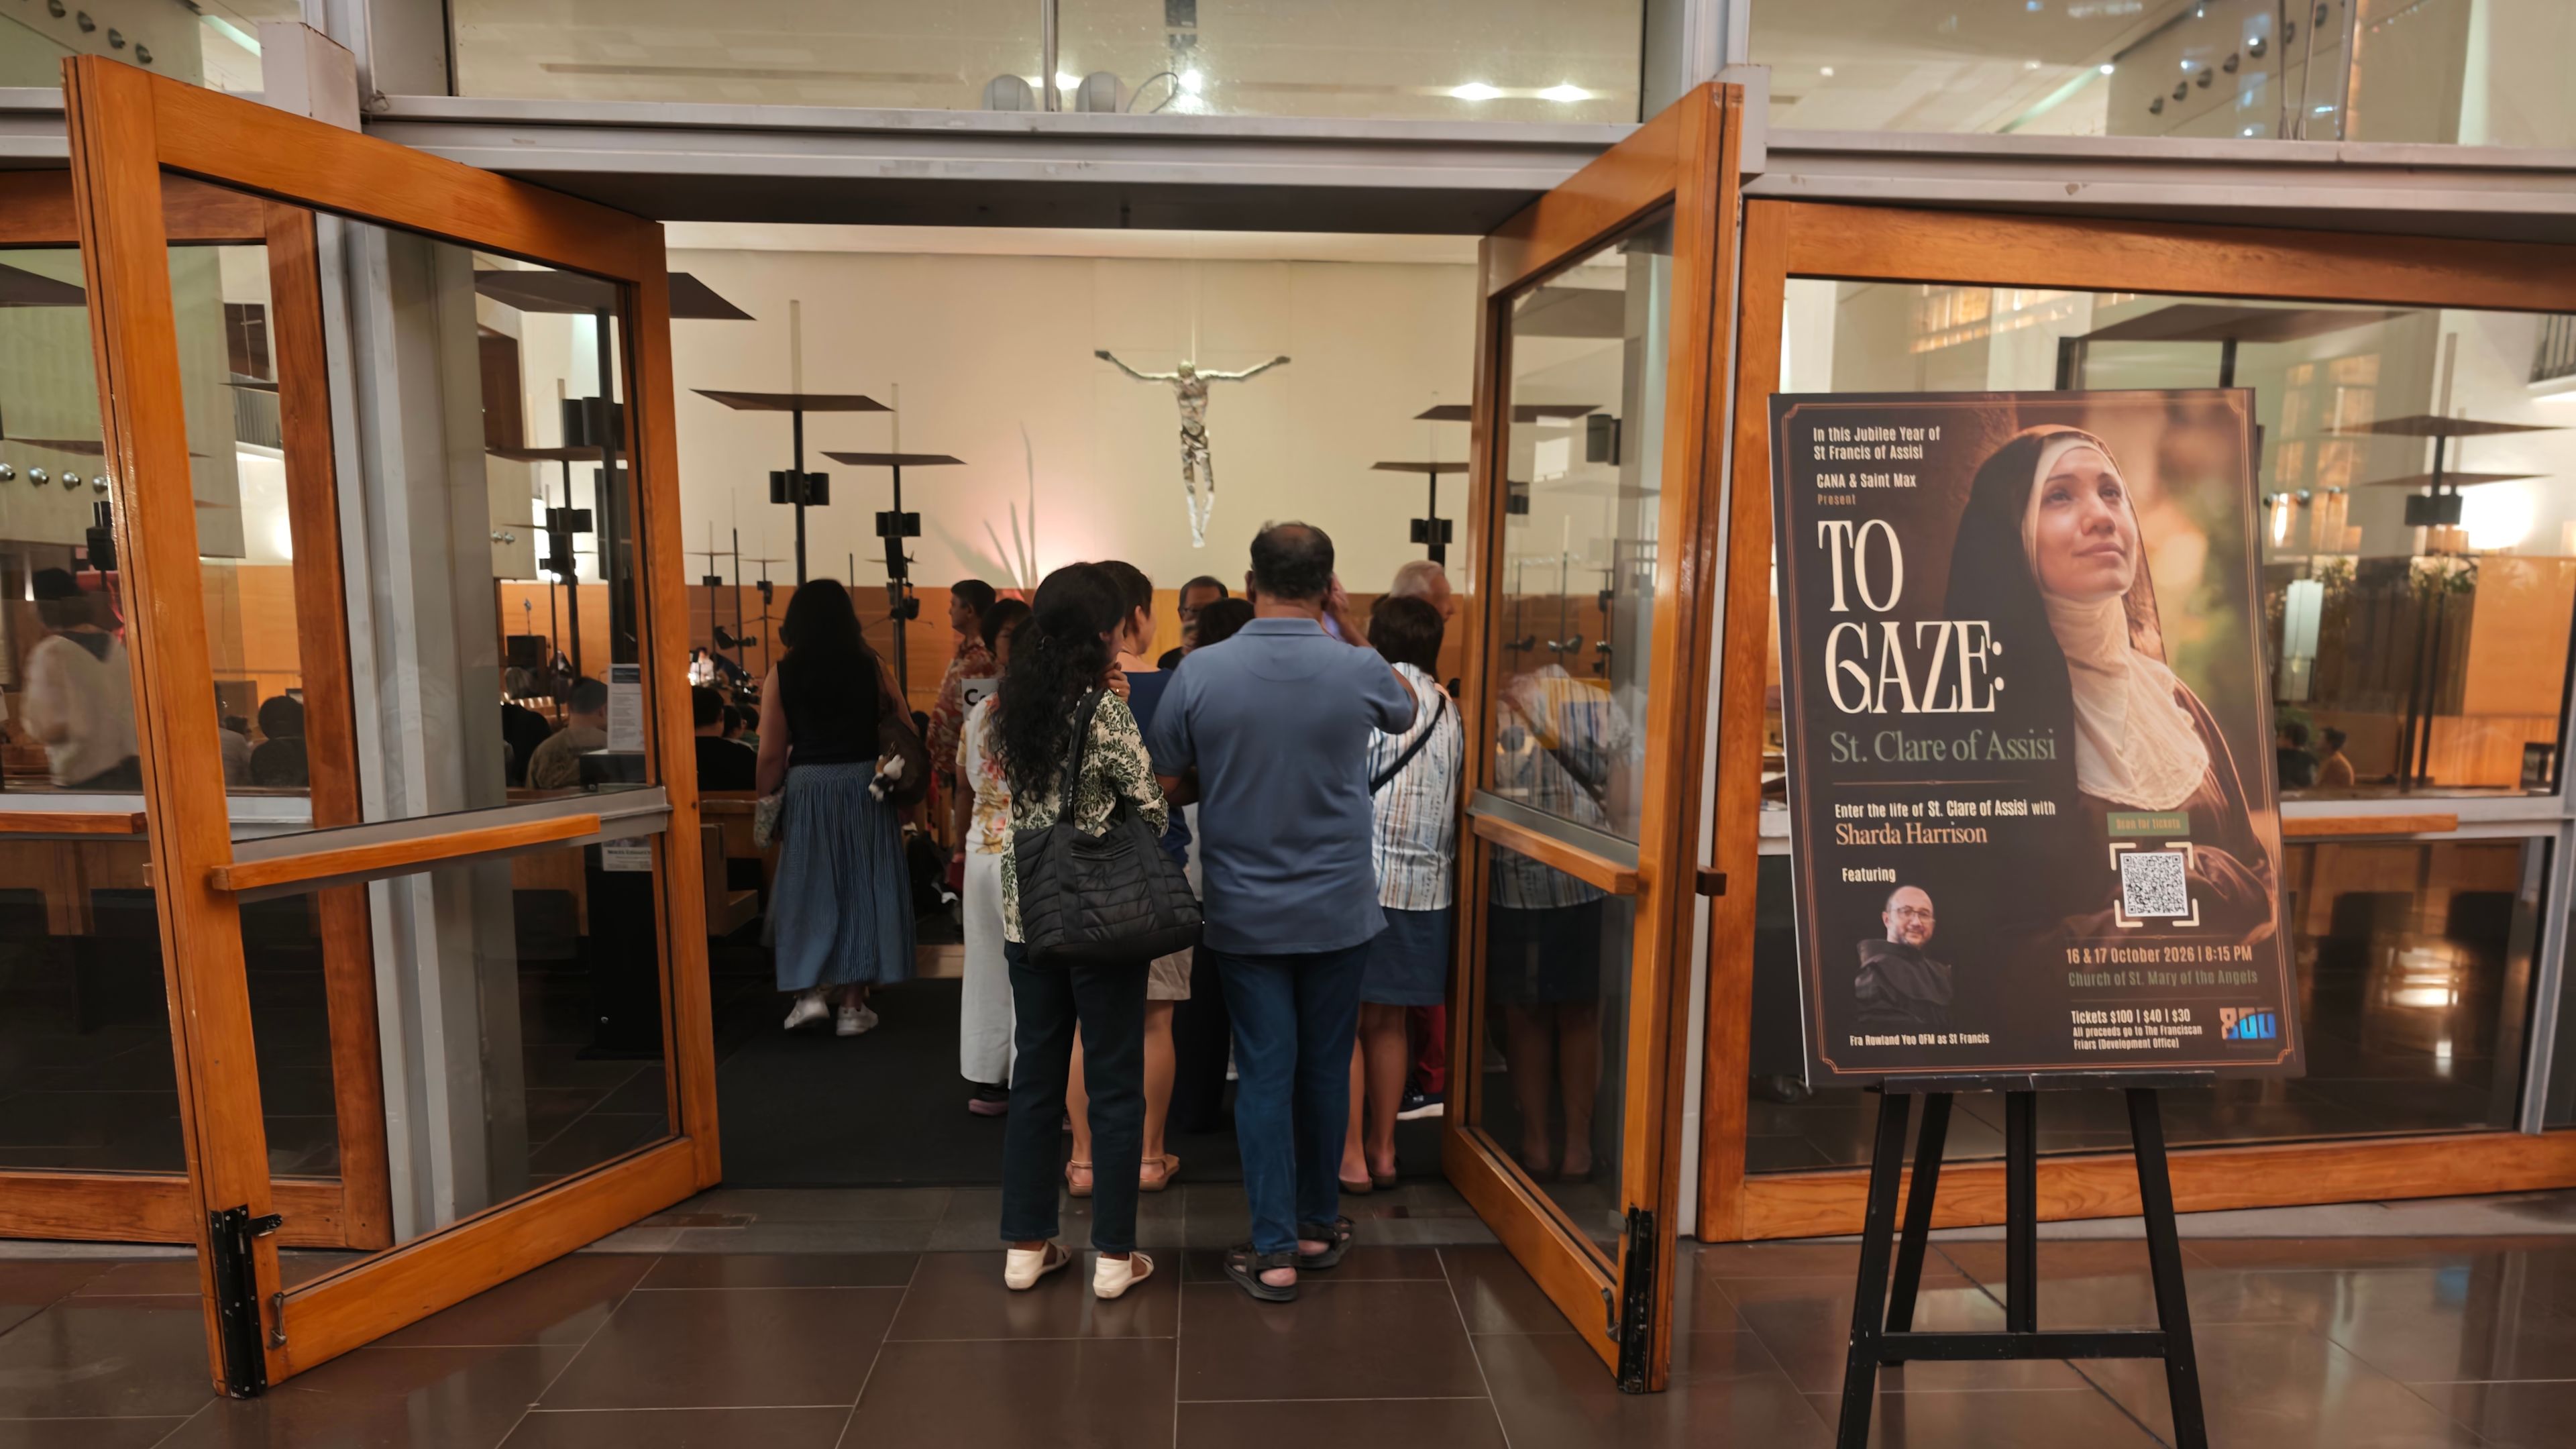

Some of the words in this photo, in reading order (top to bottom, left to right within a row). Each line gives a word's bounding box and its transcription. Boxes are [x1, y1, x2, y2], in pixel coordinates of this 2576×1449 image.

[1813, 427, 1825, 442] In
[1828, 427, 1851, 441] this
[1854, 426, 1896, 441] Jubilee
[1899, 426, 1925, 441] Year
[1929, 425, 1940, 441] of
[1814, 445, 1825, 460] St
[1829, 445, 1871, 460] Francis
[1874, 445, 1886, 460] of
[1890, 444, 1923, 460] Assisi
[1817, 473, 1846, 488] CANA
[1849, 473, 1858, 488] &
[1860, 473, 1890, 488] Saint
[1894, 473, 1917, 488] Max
[1817, 494, 1856, 505] Present
[1818, 519, 1903, 612] TO
[1825, 621, 2004, 714] GAZE:
[1830, 731, 1868, 763] St.
[1874, 730, 1945, 762] Clare
[1952, 729, 1982, 761] of
[1985, 729, 2057, 760] Assisi
[1835, 804, 1864, 818] Enter
[1868, 803, 1886, 818] the
[1889, 802, 1909, 818] life
[1912, 802, 1923, 817] of
[1927, 800, 1943, 817] St.
[1946, 800, 1977, 816] Clare
[1980, 799, 1991, 816] of
[1994, 799, 2027, 816] Assisi
[2031, 800, 2055, 816] with
[1835, 822, 1902, 845] Sharda
[1905, 821, 1988, 845] Harrison
[1841, 867, 1896, 883] Featuring
[2066, 948, 2080, 964] 16
[2083, 948, 2092, 964] &
[2094, 947, 2106, 963] 17
[2110, 947, 2160, 963] October
[2163, 946, 2195, 963] 2026
[2205, 945, 2231, 962] 8:15
[2233, 945, 2252, 961] PM
[2068, 971, 2111, 987] Church
[2114, 971, 2125, 986] of
[2148, 971, 2177, 987] Mary
[2180, 970, 2192, 985] of
[2195, 969, 2214, 985] the
[2218, 969, 2258, 985] Angels
[2071, 1010, 2108, 1024] Tickets
[2110, 1010, 2133, 1024] $100
[2143, 1008, 2162, 1024] $40
[2171, 1008, 2190, 1024] $30
[1849, 1035, 1864, 1046] Fra
[1865, 1034, 1900, 1046] Rowland
[1901, 1034, 1917, 1045] Yeo
[1919, 1034, 1935, 1045] OFM
[1937, 1034, 1947, 1044] as
[1949, 1033, 1957, 1044] St
[1960, 1032, 1990, 1044] Francis
[2073, 1026, 2084, 1037] All
[2085, 1026, 2121, 1038] proceeds
[2123, 1026, 2133, 1038] go
[2135, 1026, 2143, 1036] to
[2145, 1026, 2158, 1036] The
[2160, 1025, 2202, 1036] Franciscan
[2074, 1039, 2096, 1051] Friars
